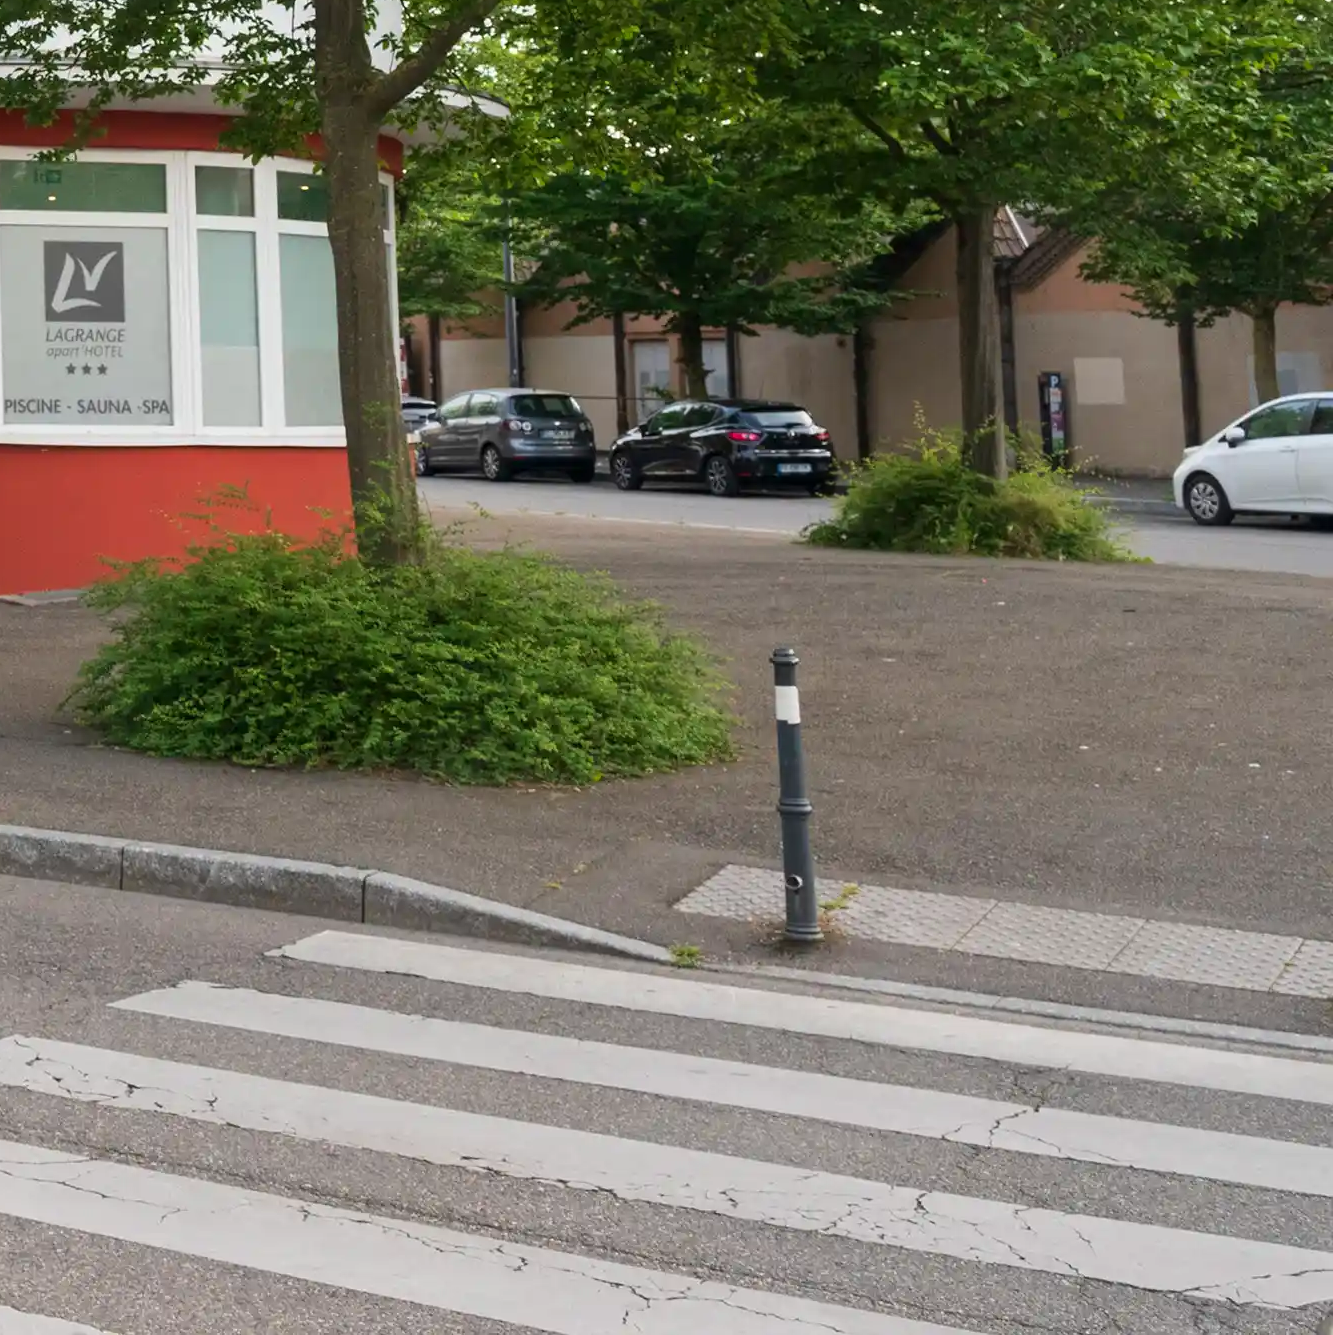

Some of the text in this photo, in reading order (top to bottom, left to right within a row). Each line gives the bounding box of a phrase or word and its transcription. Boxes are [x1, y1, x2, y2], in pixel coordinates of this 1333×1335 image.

[45, 328, 126, 343] LAGRANGE
[1050, 375, 1059, 388] P
[4, 398, 62, 414] PISCINE
[77, 398, 133, 414] SAUNA
